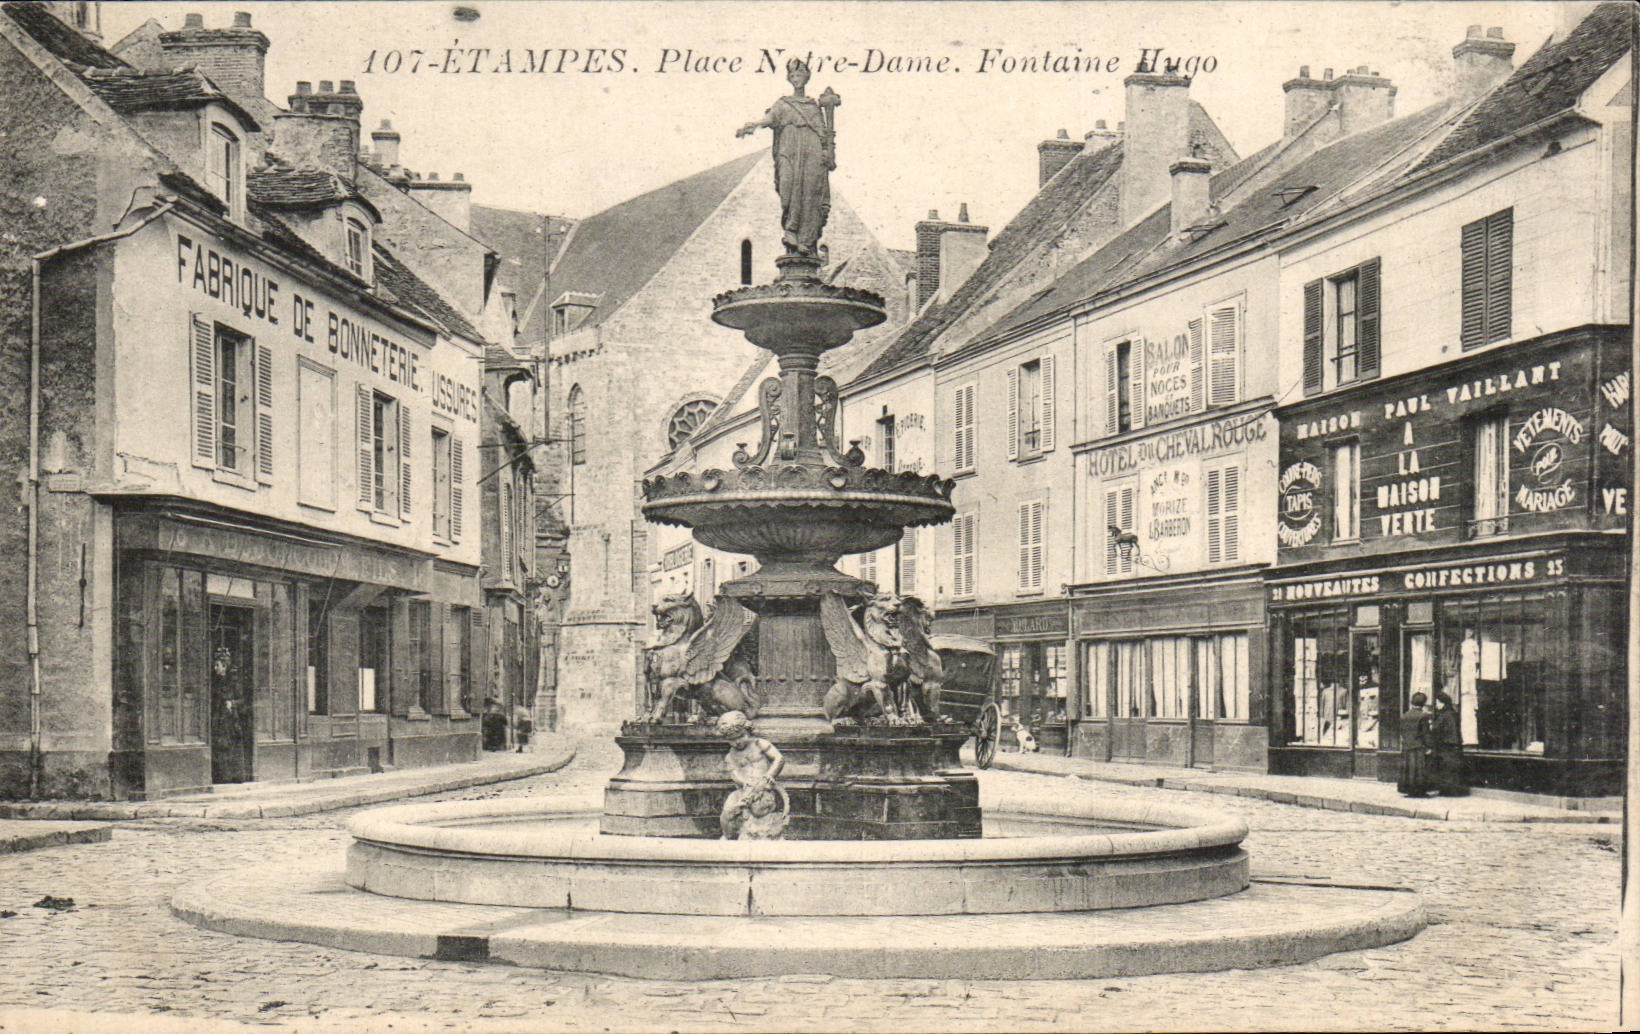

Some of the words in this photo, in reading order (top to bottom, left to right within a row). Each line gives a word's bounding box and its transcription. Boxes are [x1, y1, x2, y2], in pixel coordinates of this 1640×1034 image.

[177, 234, 278, 326] FABRIQUE
[293, 293, 314, 344] DE
[1146, 334, 1190, 369] SALON
[1150, 374, 1187, 398] NOCES
[1296, 410, 1361, 440] MAISON
[1384, 394, 1432, 420] PAUL
[1447, 361, 1562, 404] VAILLANT
[1147, 396, 1191, 422] BANQUETS
[1403, 421, 1414, 446] A
[1398, 450, 1420, 476] LA
[1286, 491, 1312, 513] TAPIS
[1377, 476, 1441, 509] MAISON
[1515, 478, 1576, 513] MARIAGE
[1380, 508, 1436, 537] VERTE
[1286, 576, 1380, 600] NOUVEAUTES
[1404, 561, 1535, 590] CONFECTIONS
